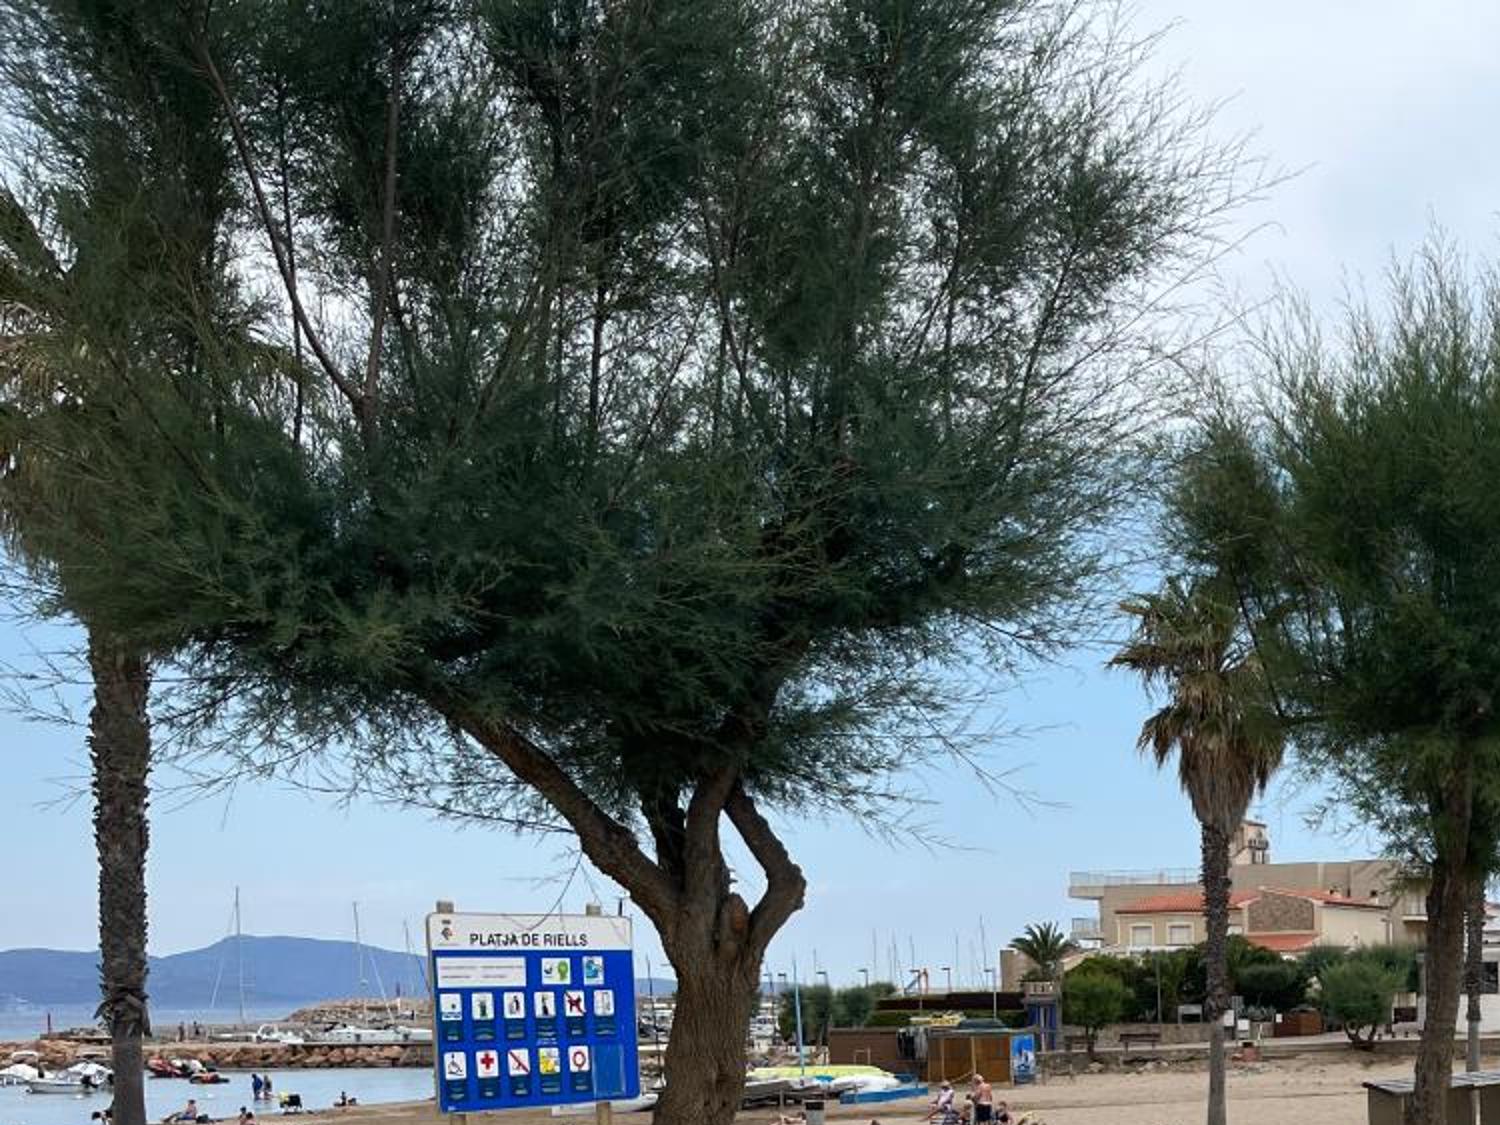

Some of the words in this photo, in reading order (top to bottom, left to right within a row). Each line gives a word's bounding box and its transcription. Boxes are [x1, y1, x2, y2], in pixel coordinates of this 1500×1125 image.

[469, 933, 519, 946] PLATJA
[521, 933, 540, 946] DE
[543, 933, 588, 947] RIELLS
